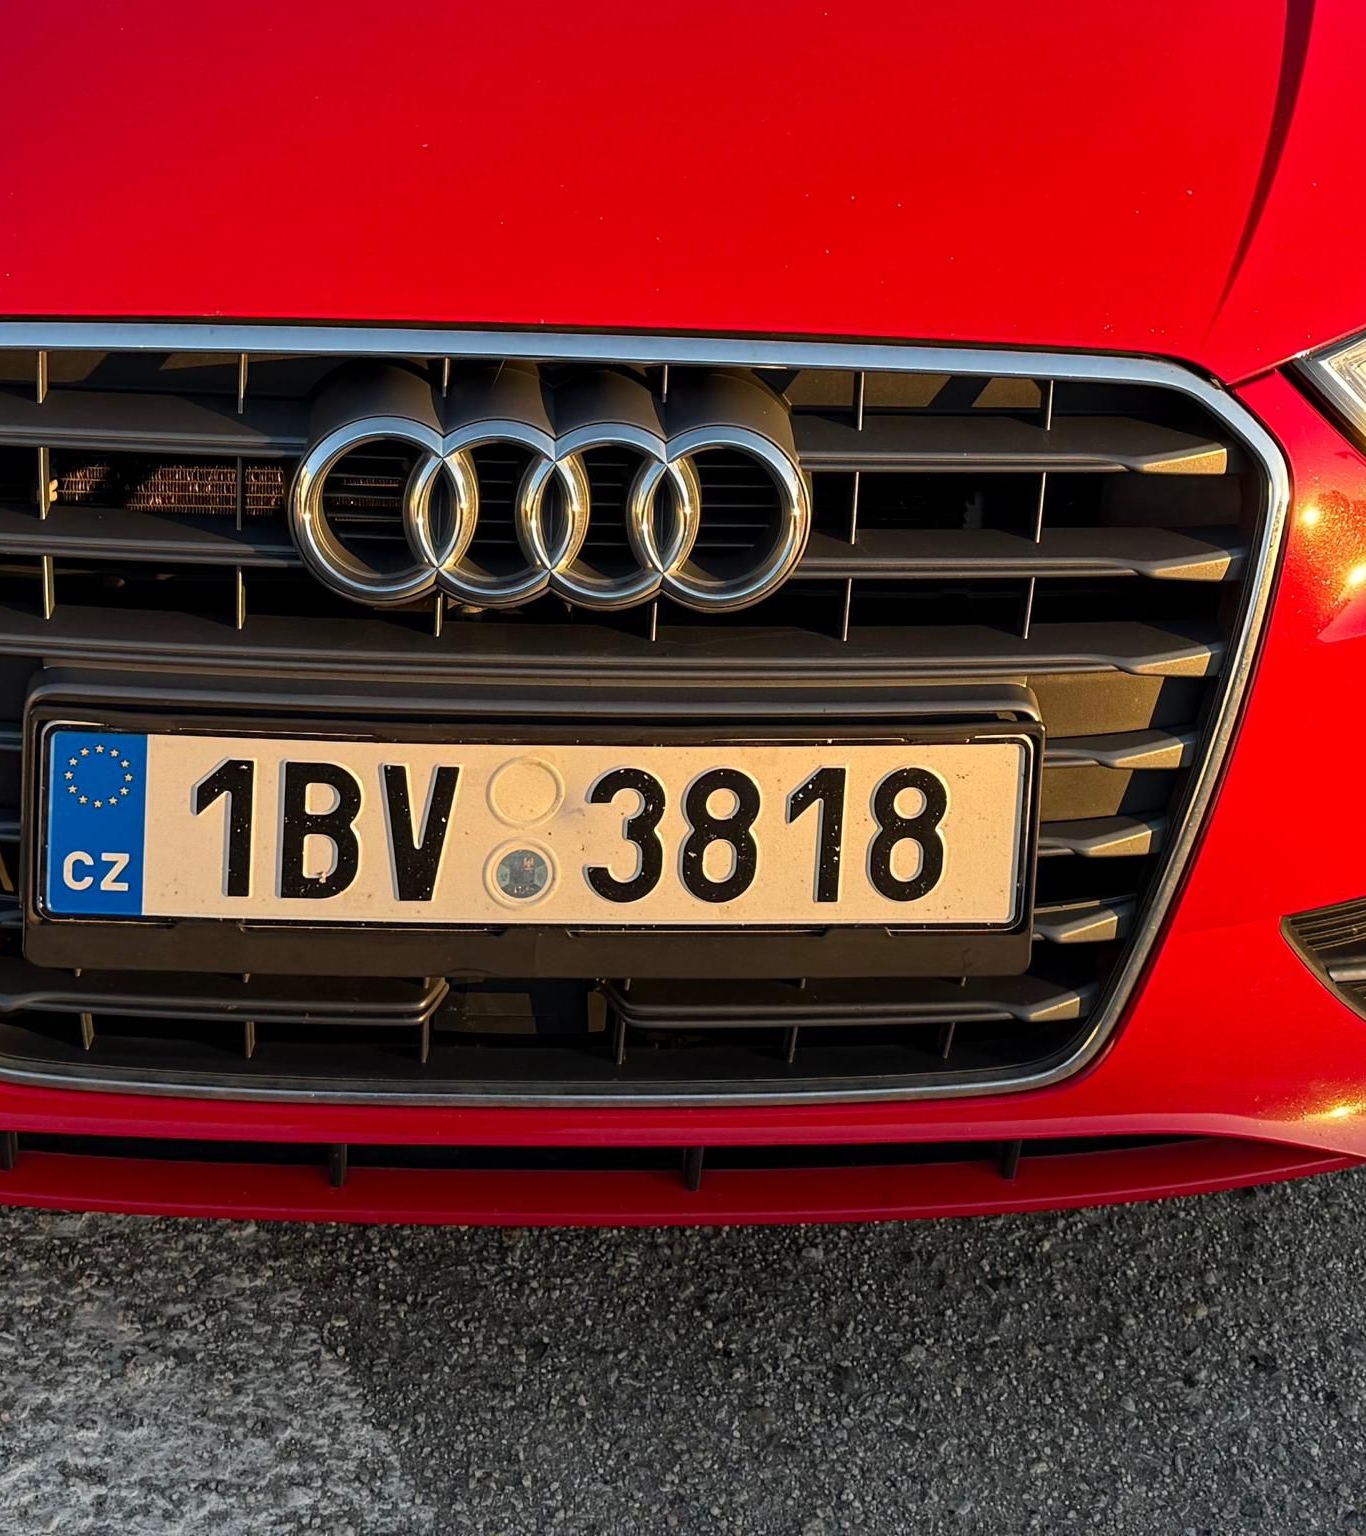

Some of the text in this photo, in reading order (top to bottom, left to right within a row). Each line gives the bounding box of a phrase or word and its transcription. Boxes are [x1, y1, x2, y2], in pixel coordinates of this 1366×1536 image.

[62, 850, 131, 892] CZ
[191, 758, 950, 904] 1BV 3818
